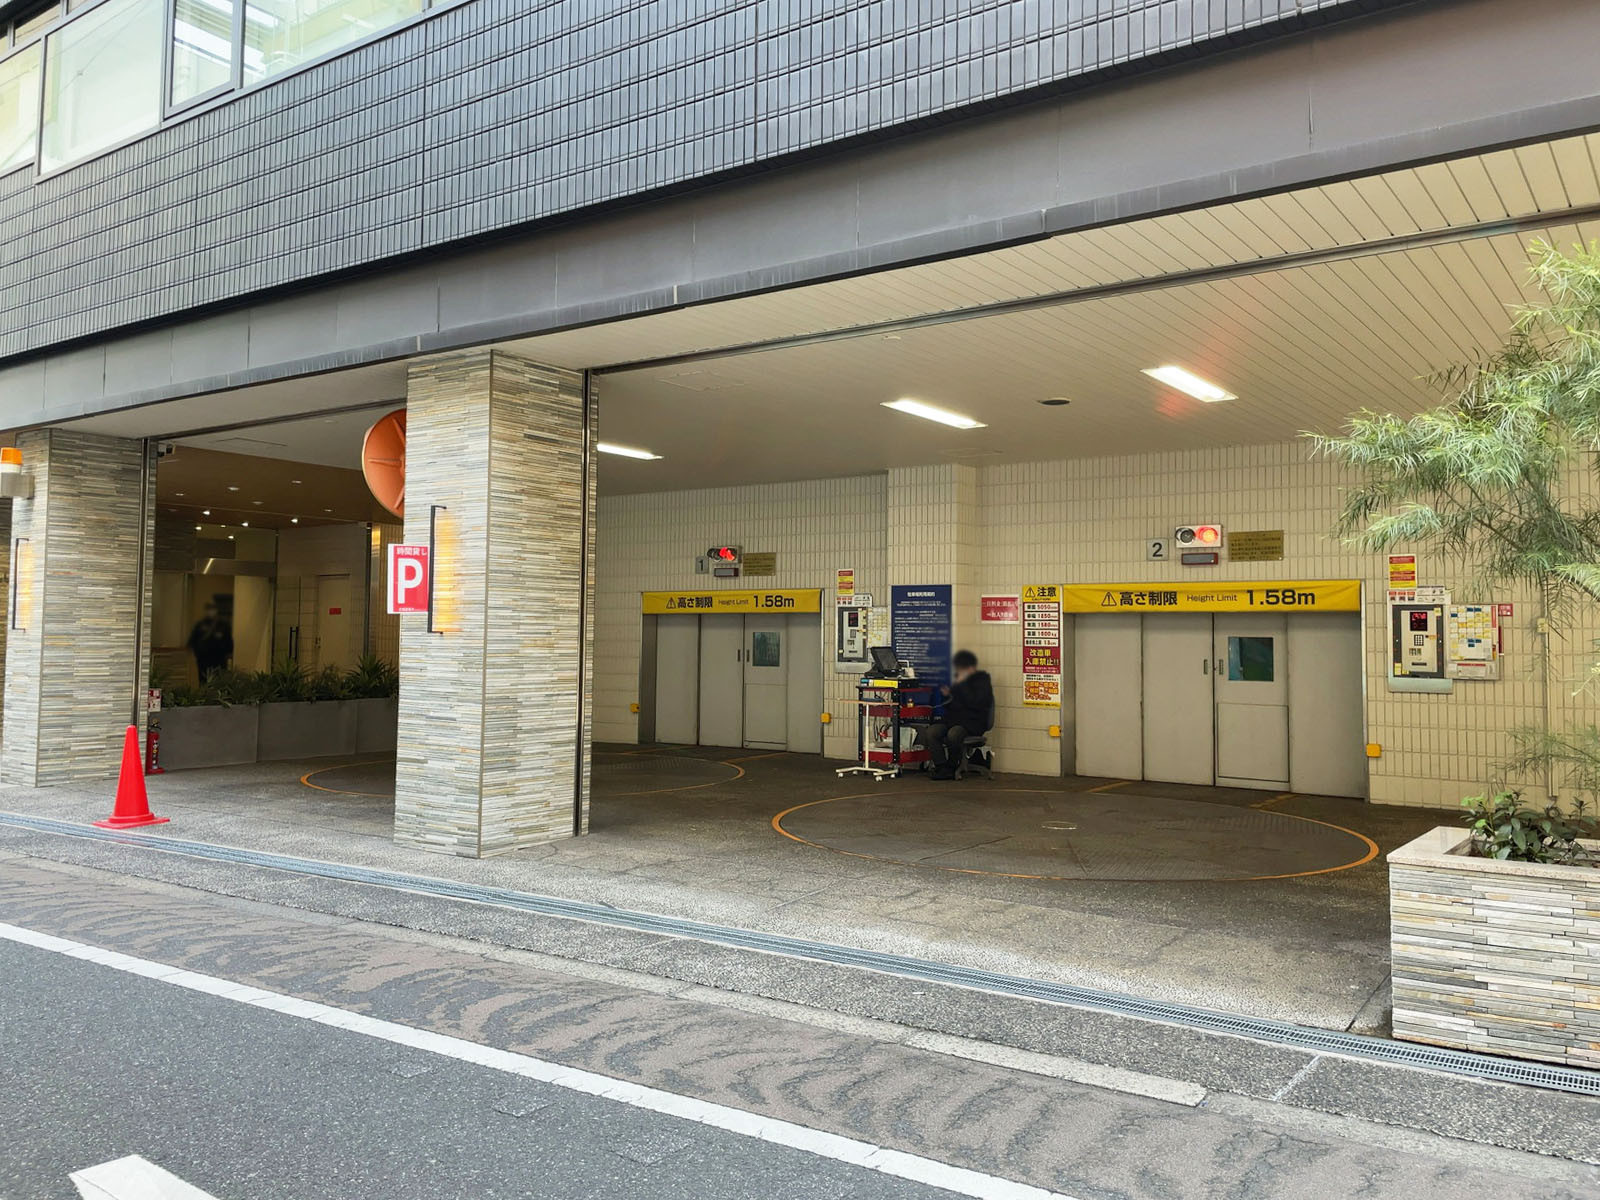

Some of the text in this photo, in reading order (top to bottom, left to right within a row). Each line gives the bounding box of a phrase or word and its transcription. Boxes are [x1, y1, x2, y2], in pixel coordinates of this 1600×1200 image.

[396, 547, 427, 556] 時間貸し
[1152, 542, 1163, 558] 2
[698, 560, 705, 571] 1
[397, 558, 423, 604] P
[1037, 586, 1056, 597] 注意
[1119, 588, 1316, 606] 高さ制限 Height Limit 1.58m
[677, 596, 713, 609] 高さ制限
[718, 598, 736, 606] Height
[753, 594, 795, 608] 1.58m
